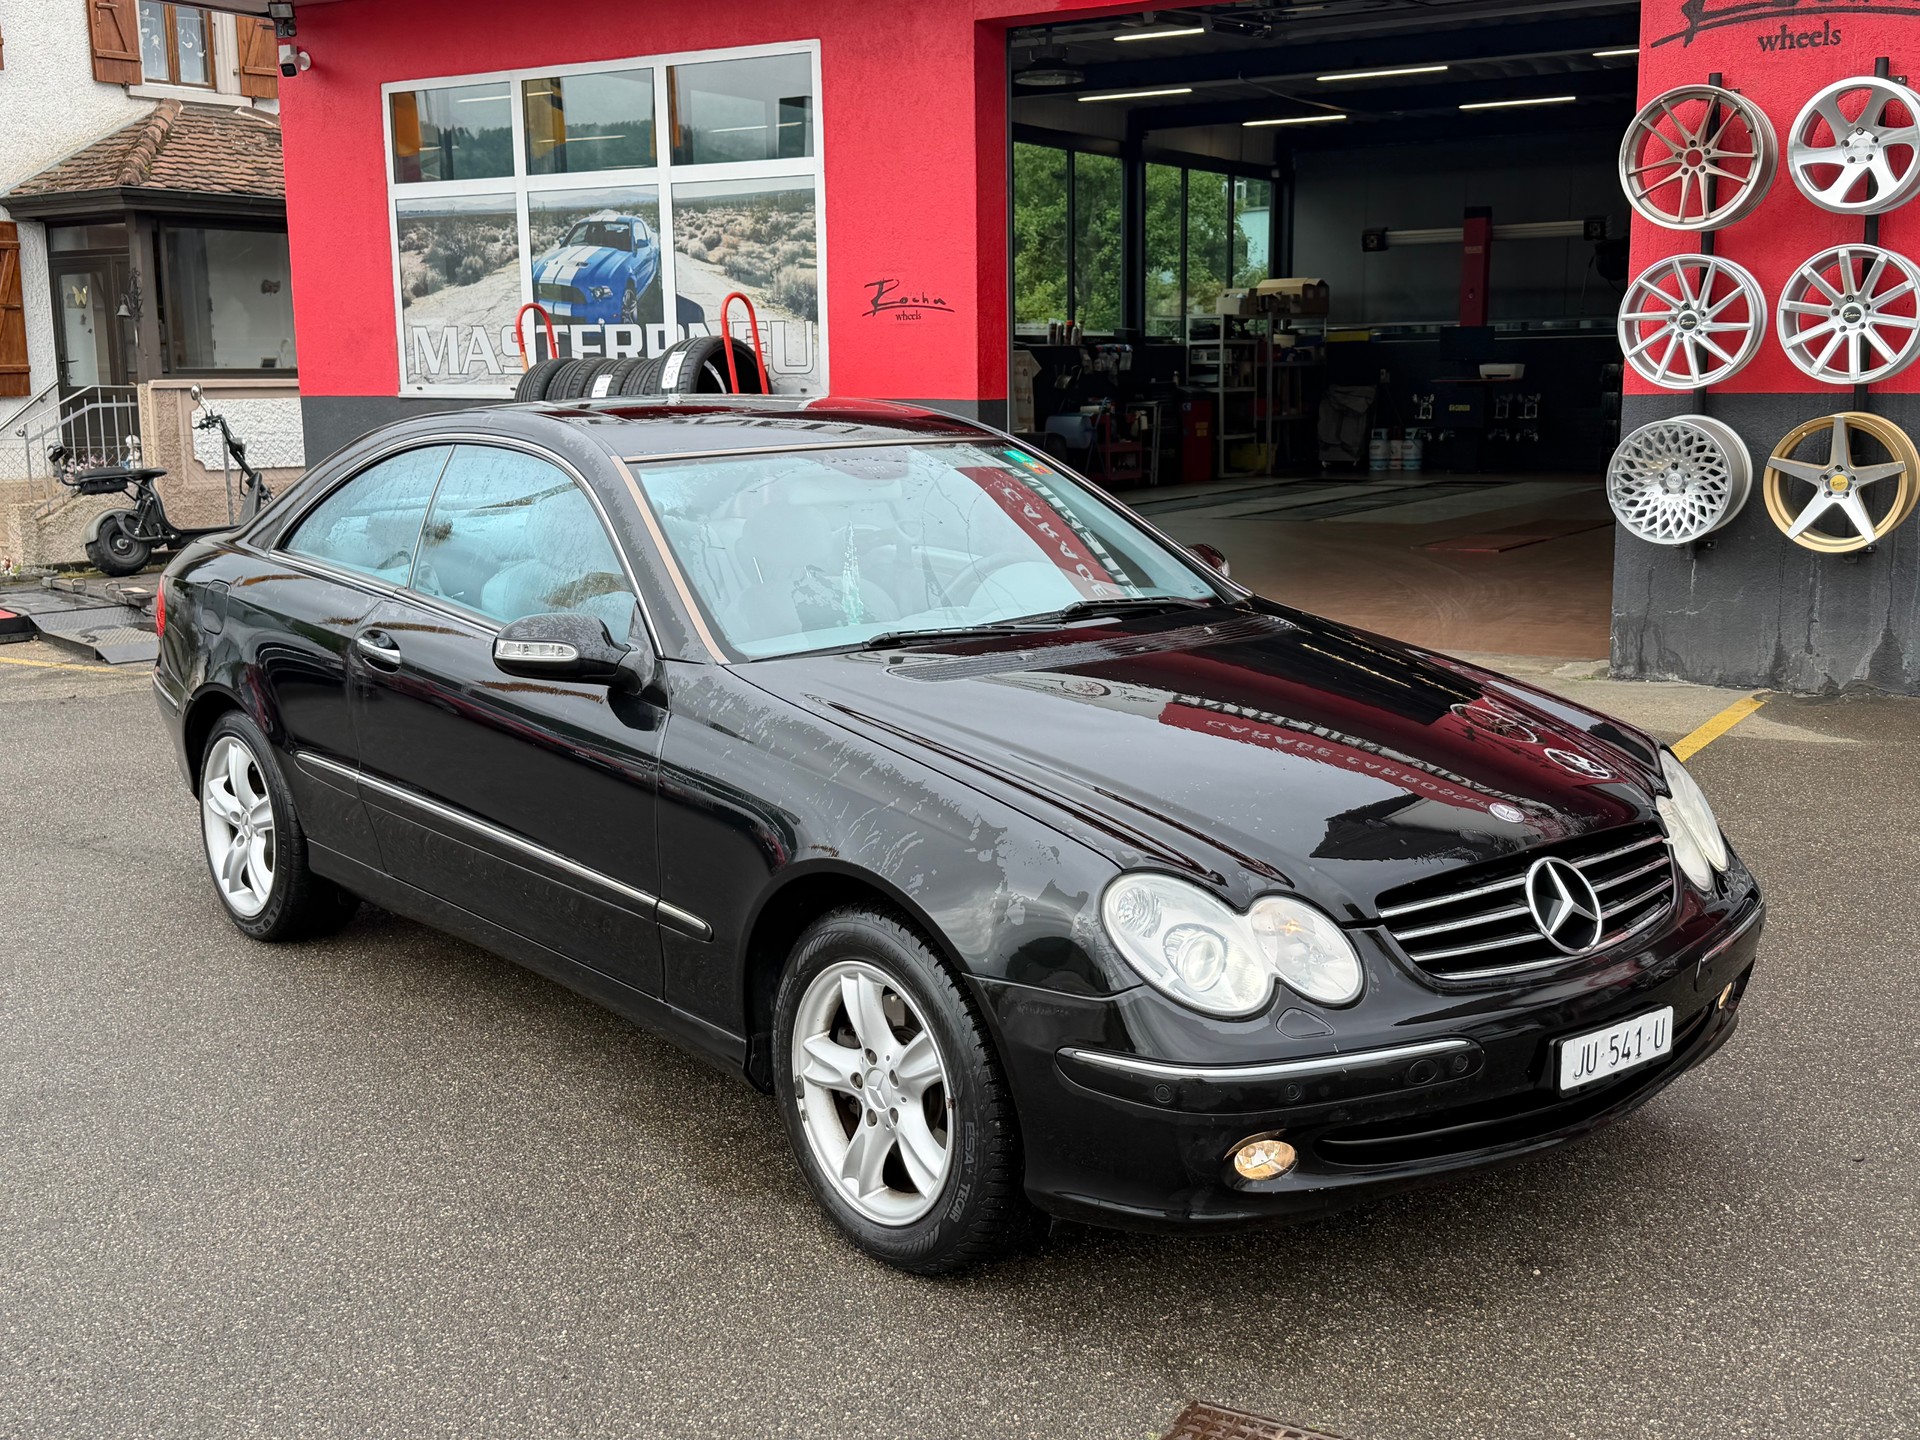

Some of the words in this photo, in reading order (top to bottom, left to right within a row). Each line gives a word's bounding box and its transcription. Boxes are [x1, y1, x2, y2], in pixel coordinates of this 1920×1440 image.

[1757, 20, 1842, 52] wheels
[863, 278, 947, 317] Rocha
[895, 309, 922, 321] wheels
[1573, 1041, 1598, 1078] JU
[1608, 1026, 1642, 1067] 541
[1654, 1016, 1666, 1050] U
[949, 1183, 971, 1223] TECAR
